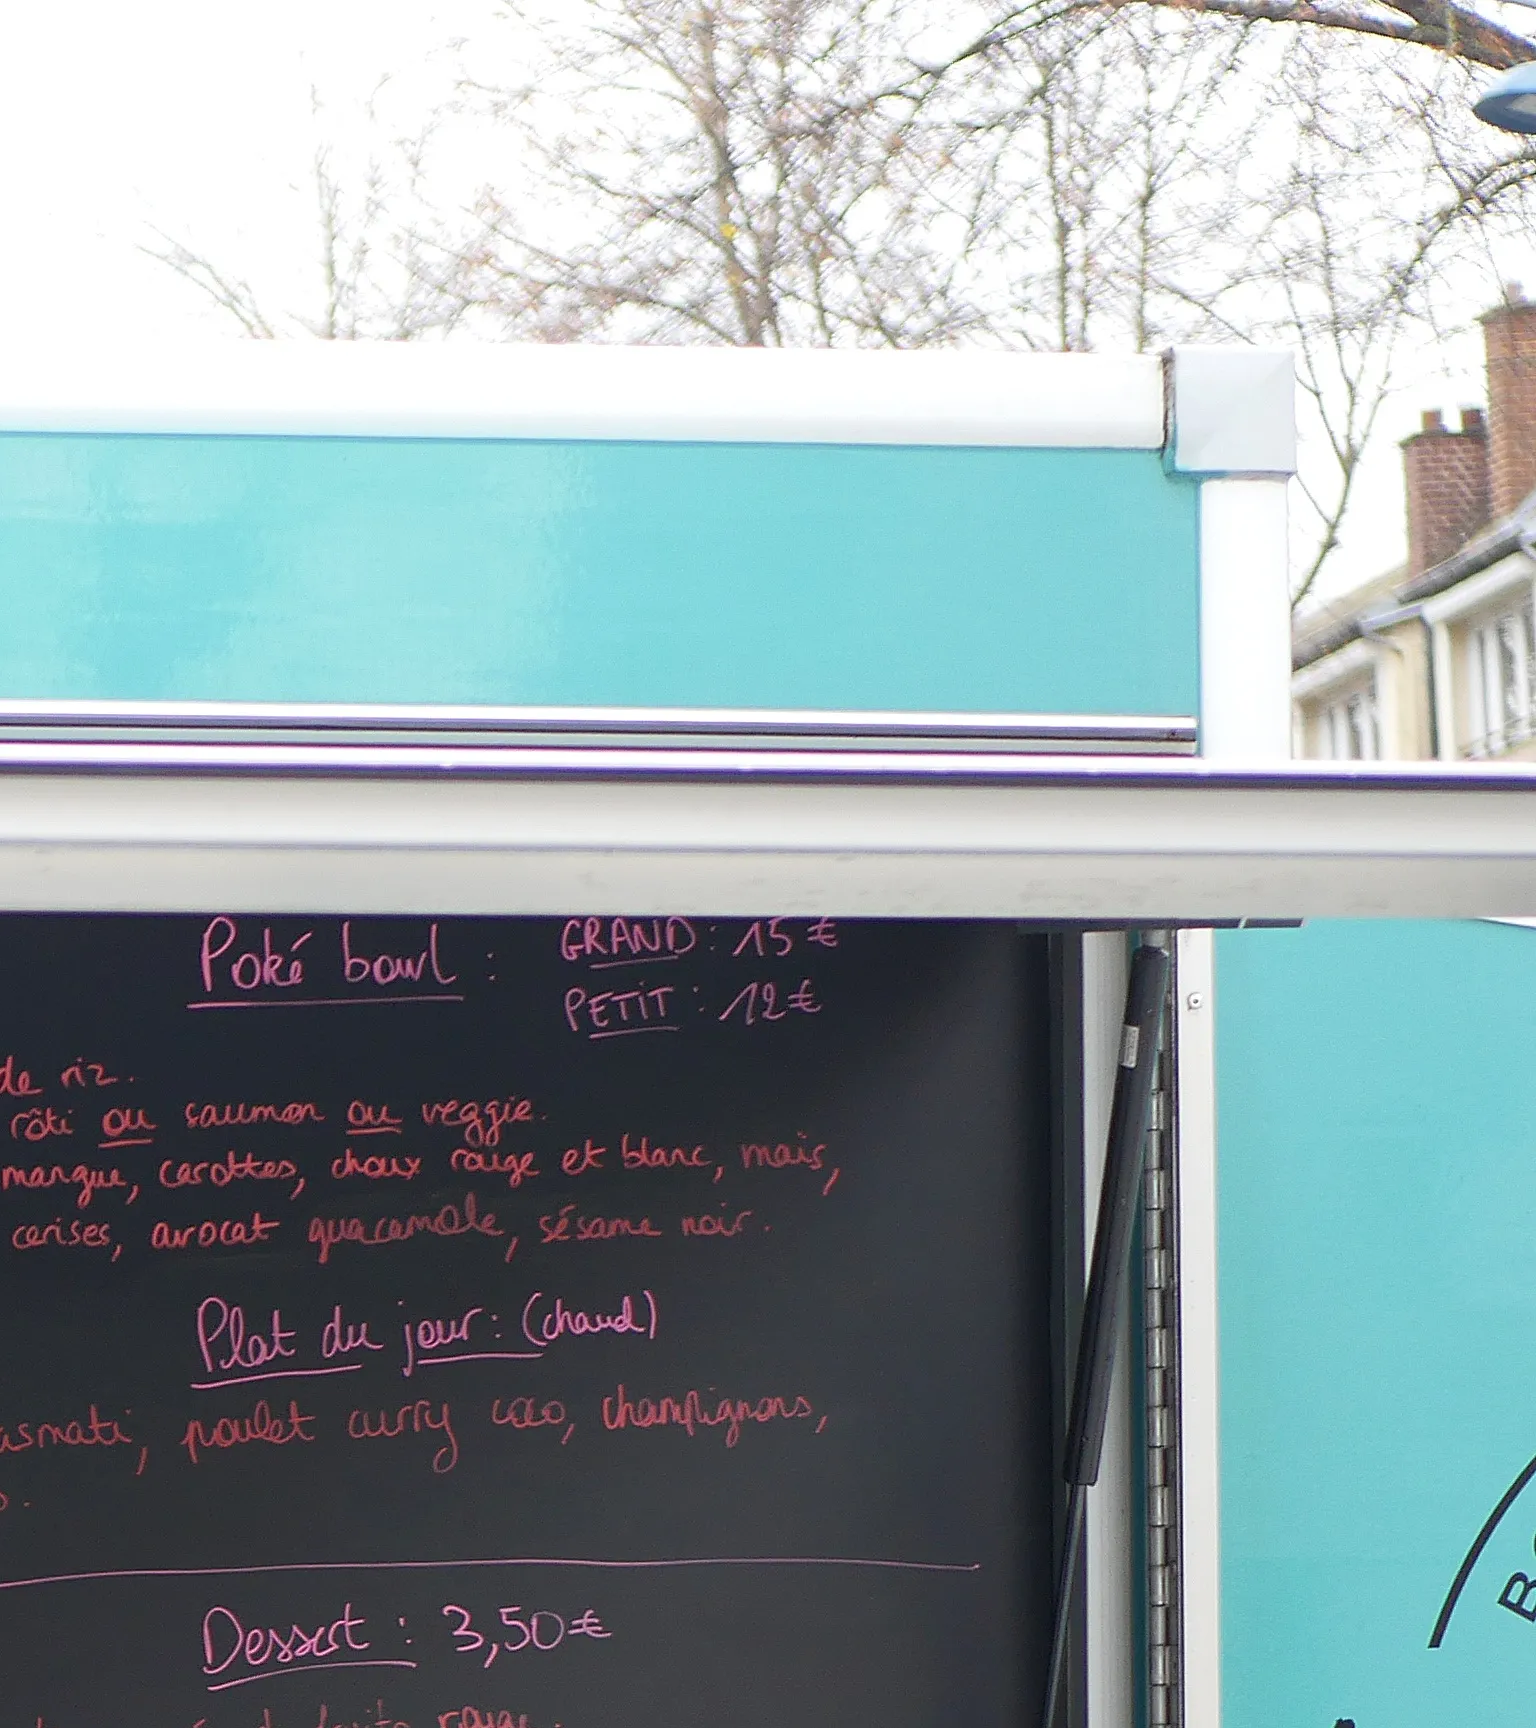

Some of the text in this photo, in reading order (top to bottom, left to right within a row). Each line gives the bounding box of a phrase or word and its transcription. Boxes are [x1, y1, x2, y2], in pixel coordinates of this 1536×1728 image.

[199, 915, 313, 992] Poké
[9, 1108, 73, 1141] rôti
[102, 1103, 156, 1137] ou
[184, 1099, 326, 1127] saumon
[346, 1101, 403, 1127] ou
[329, 1150, 421, 1180] choux
[449, 1148, 540, 1187] rouge
[562, 1139, 607, 1175] et
[151, 1212, 280, 1250] avocat
[195, 1296, 296, 1372] Plat
[321, 1305, 383, 1357] du
[180, 1399, 316, 1464] poulet
